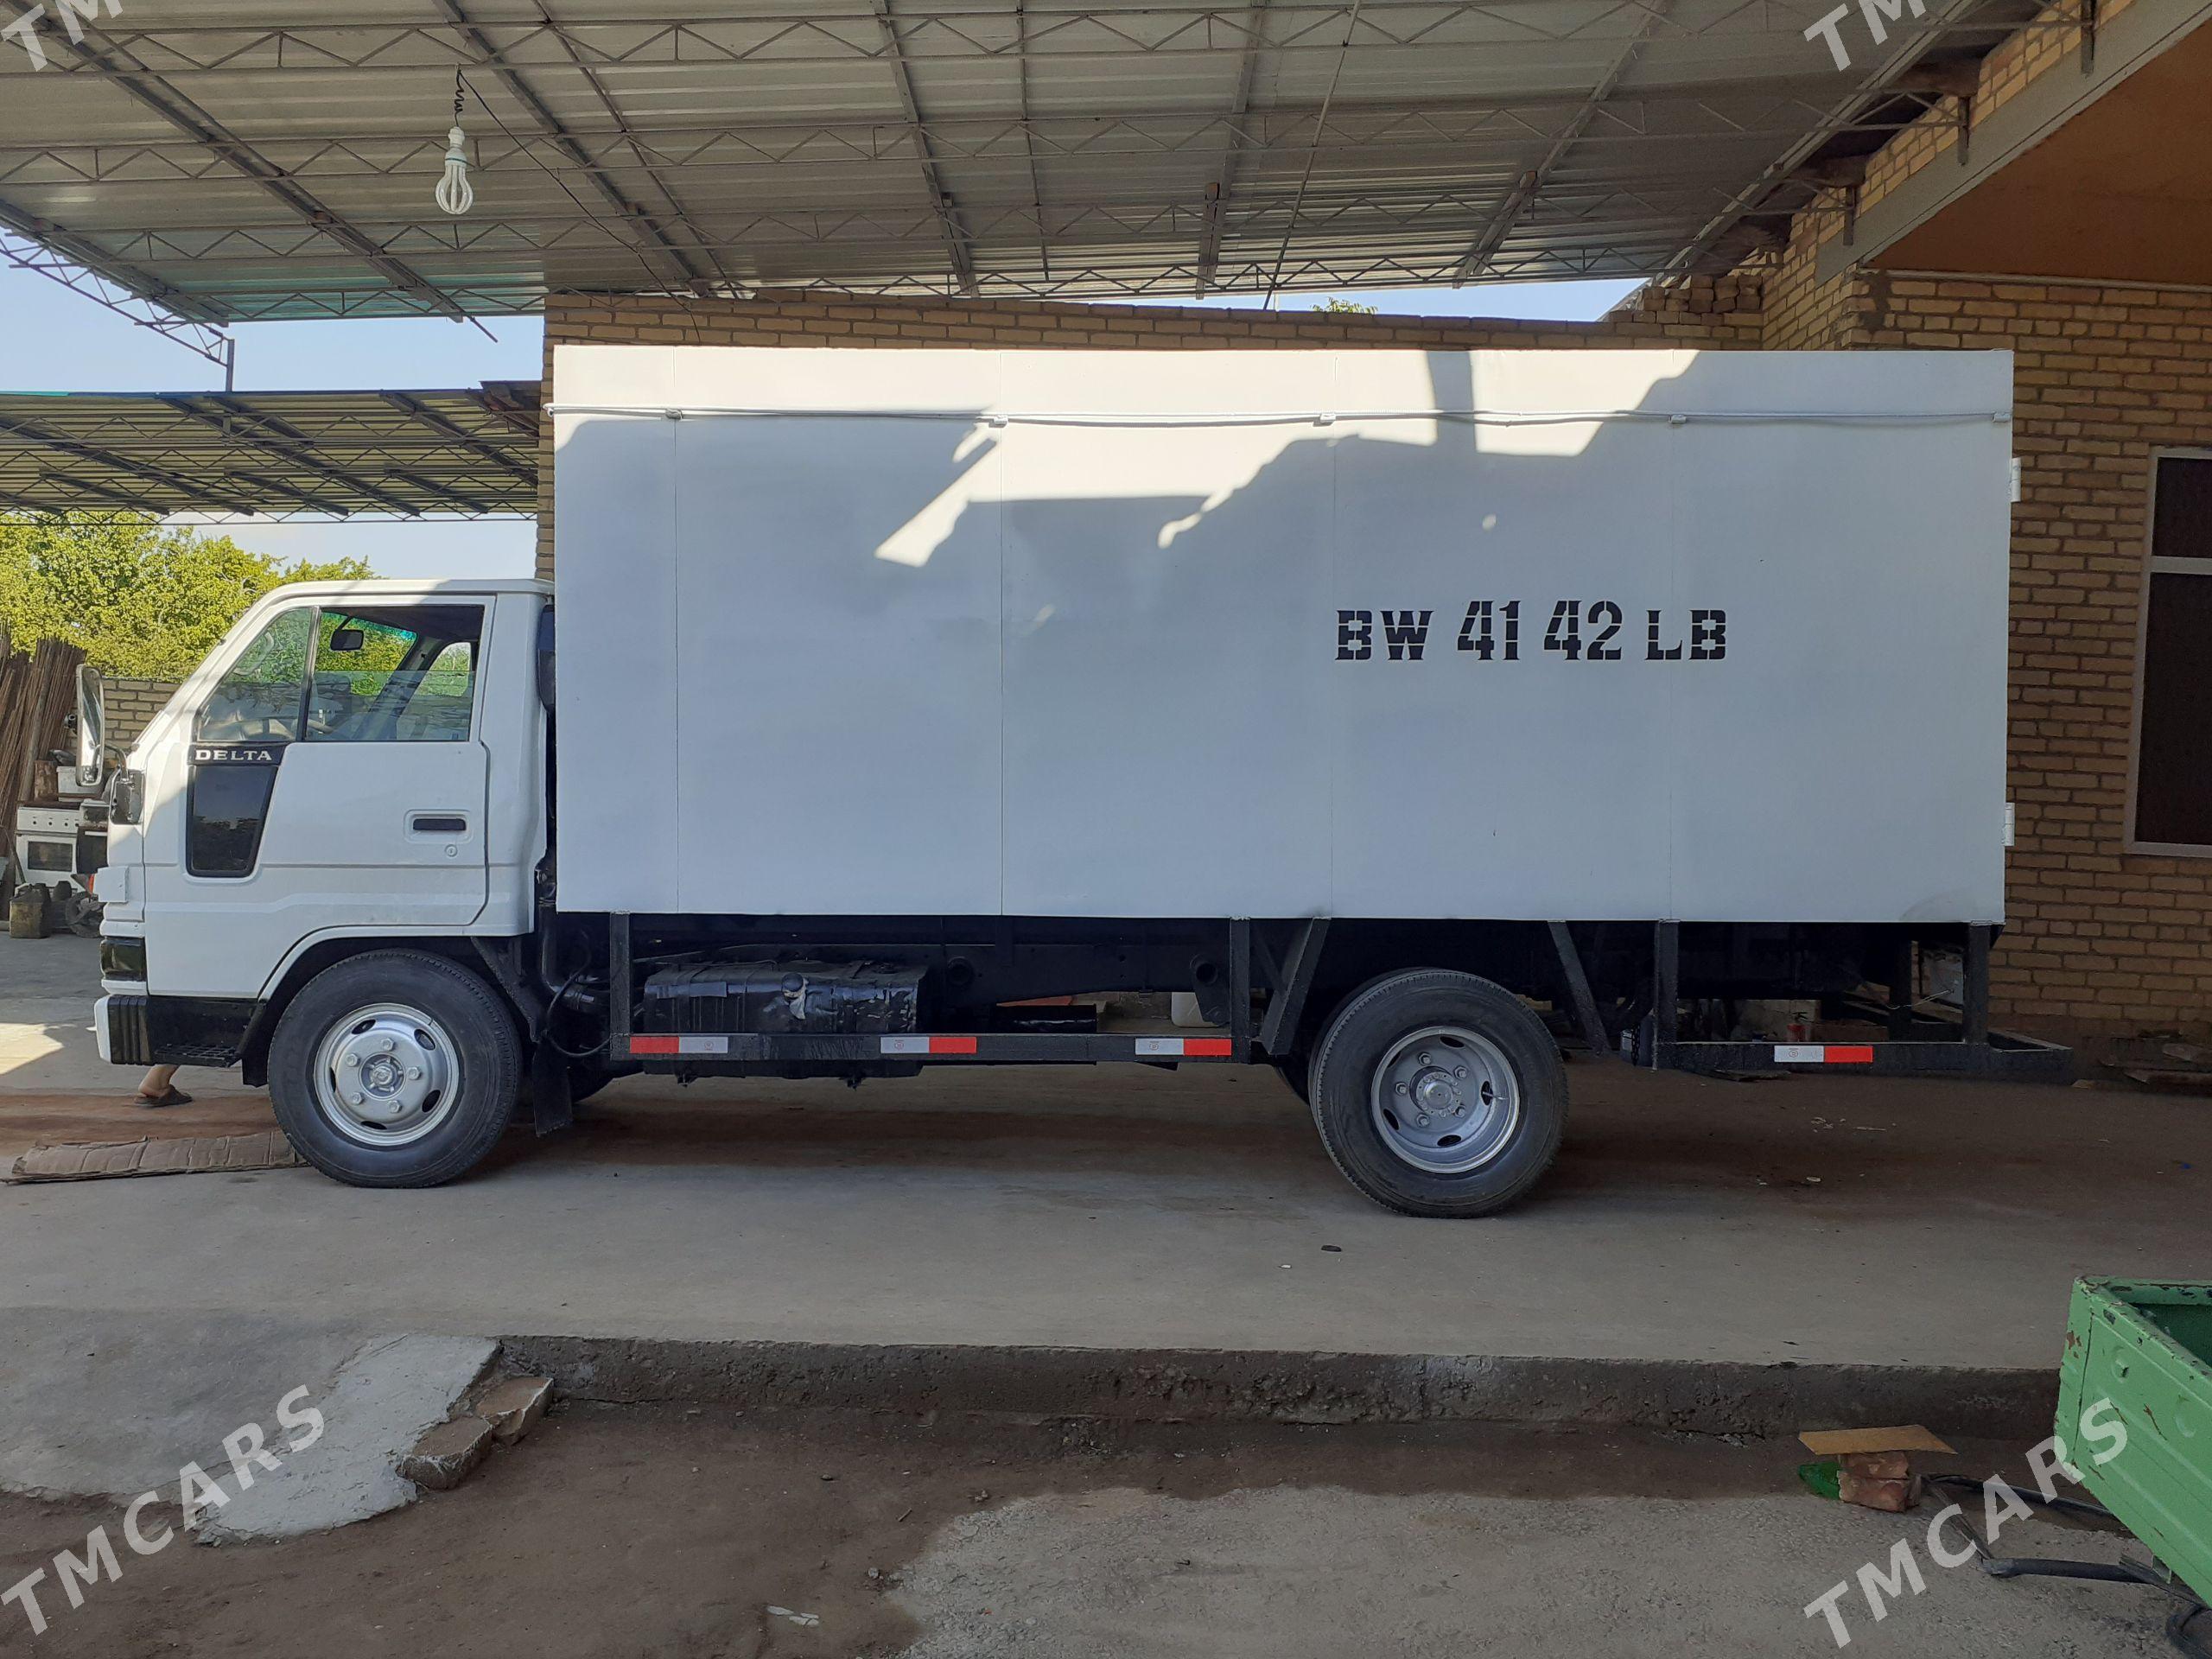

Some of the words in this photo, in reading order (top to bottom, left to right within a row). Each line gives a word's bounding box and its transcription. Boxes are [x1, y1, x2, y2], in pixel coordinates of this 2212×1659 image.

[1335, 610, 1434, 660] BW
[1644, 609, 1726, 660] LB
[195, 749, 272, 760] DELTA
